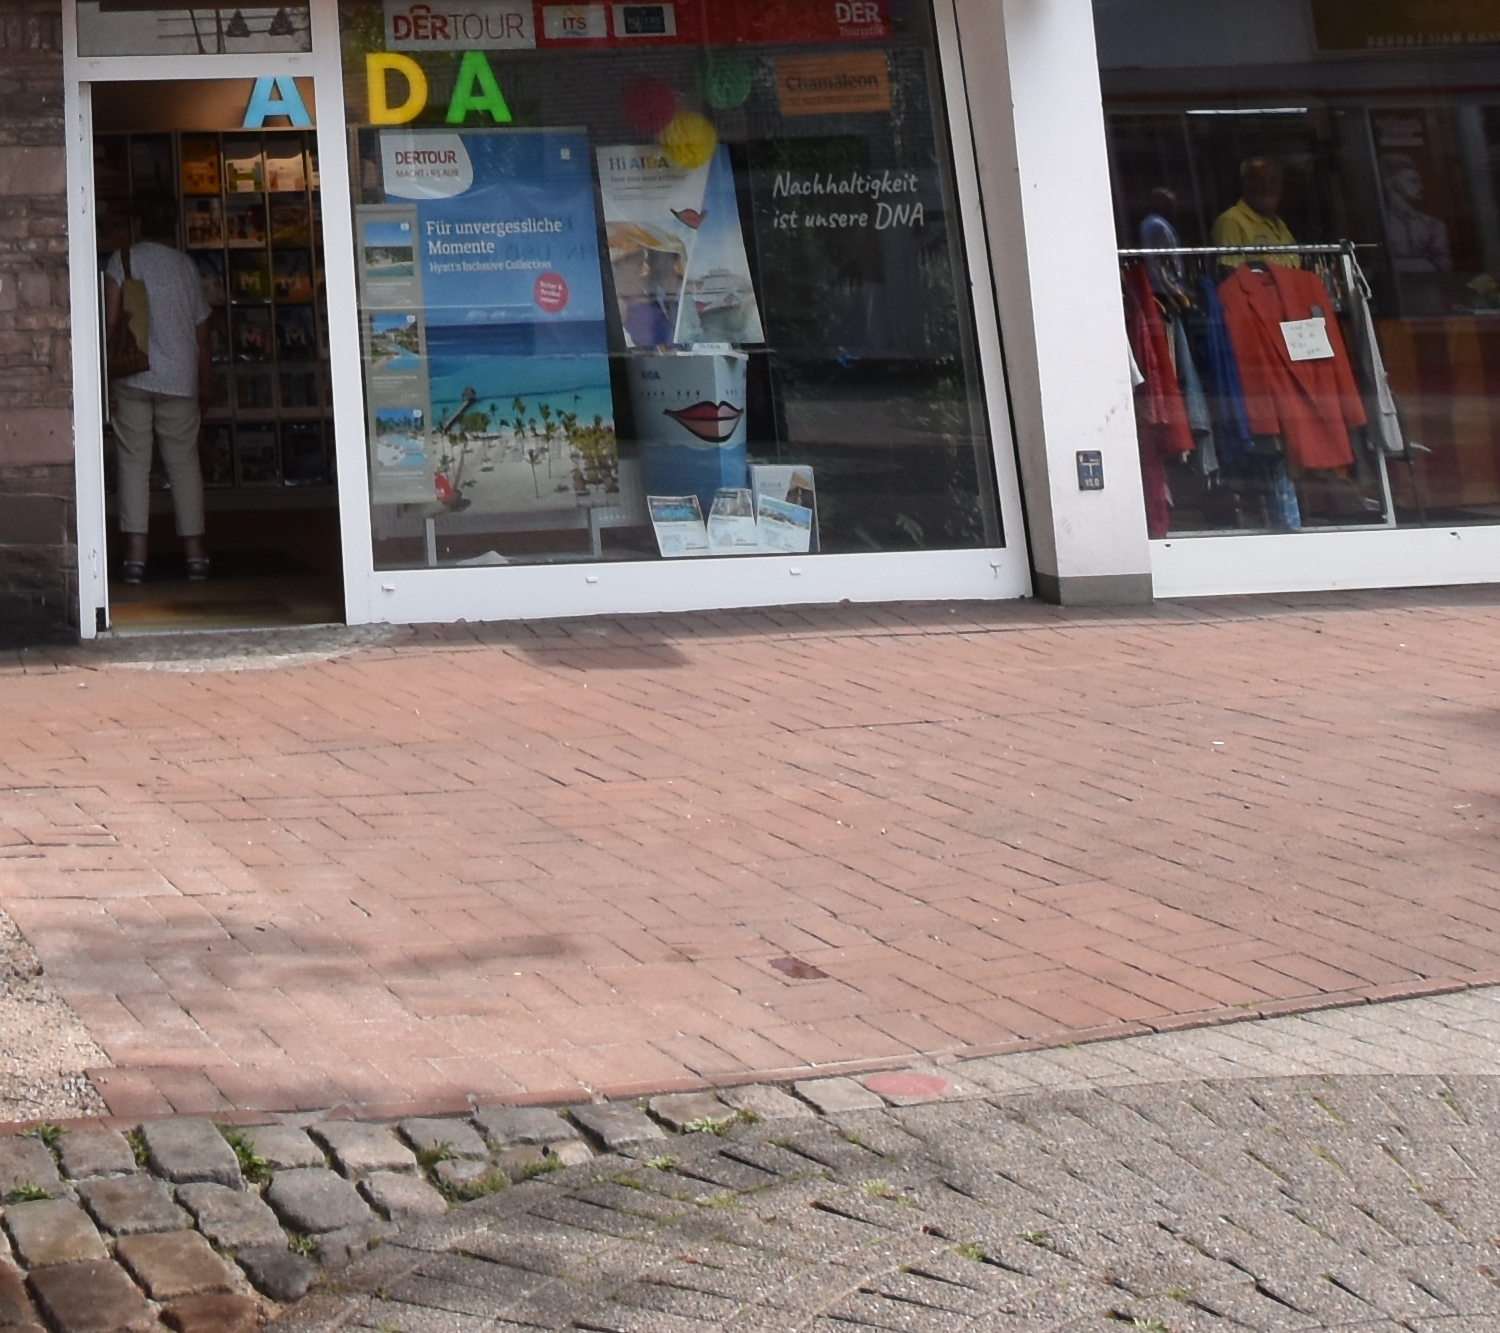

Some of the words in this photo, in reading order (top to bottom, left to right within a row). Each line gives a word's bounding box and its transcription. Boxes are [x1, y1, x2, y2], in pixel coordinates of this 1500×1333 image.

[835, 1, 882, 24] DER
[393, 11, 524, 41] DERTOUR
[562, 17, 588, 30] ITS
[395, 150, 458, 165] DERTOUR
[772, 169, 919, 200] Nachhaltigkeit
[773, 210, 799, 229] ist
[804, 213, 869, 228] unsere
[874, 201, 925, 231] DNA
[426, 220, 452, 235] Für
[454, 217, 563, 237] unvergessliche
[428, 239, 495, 255] Momente
